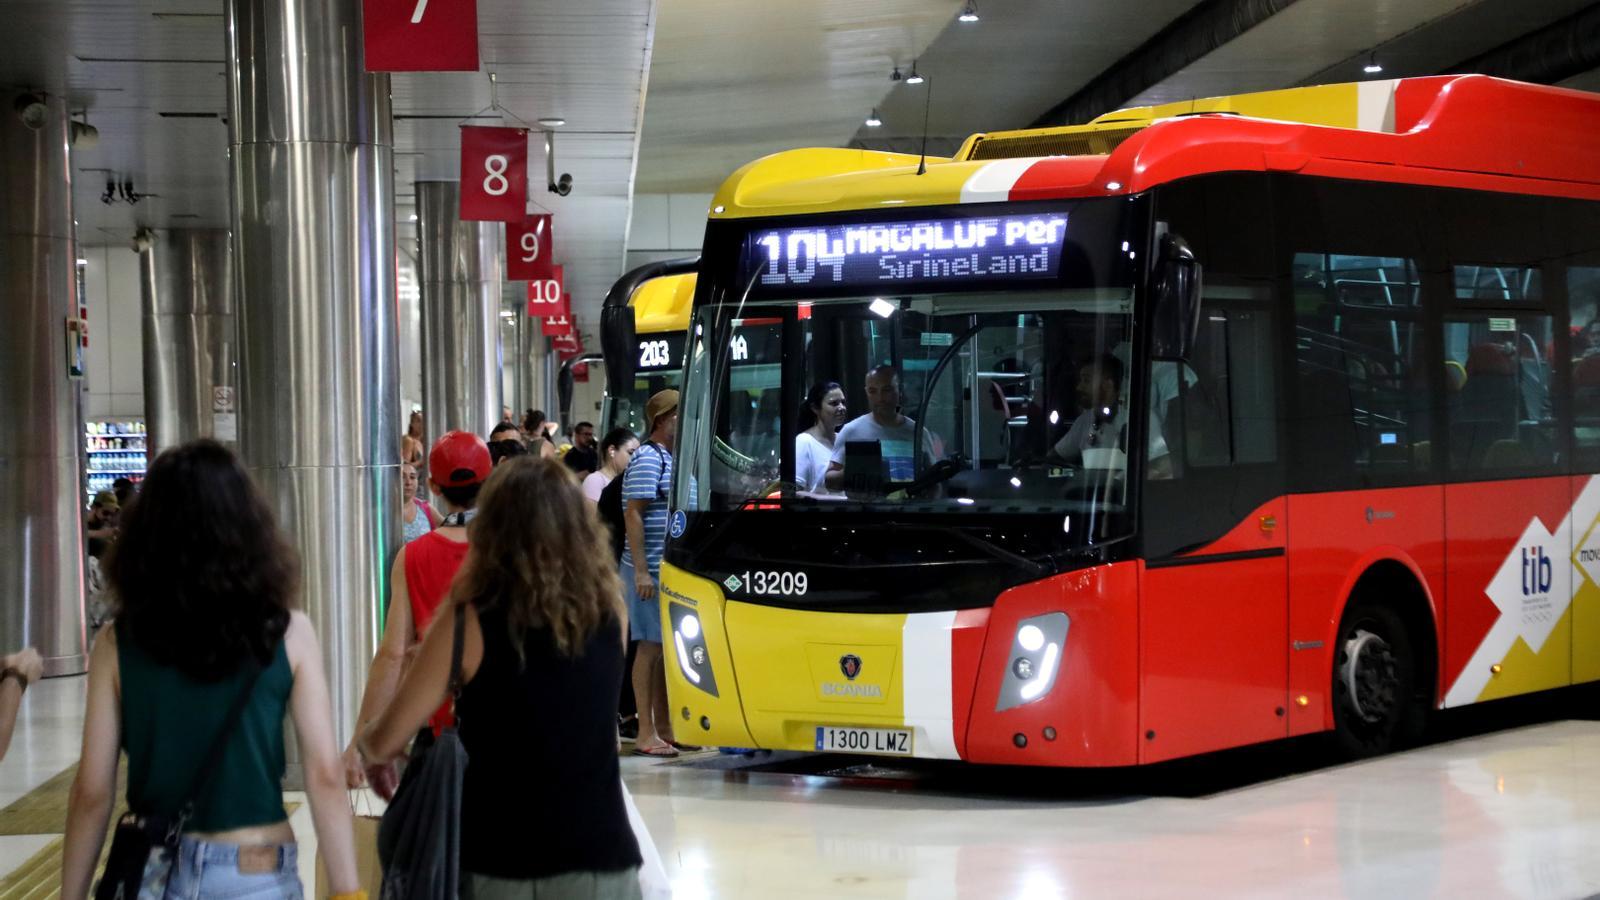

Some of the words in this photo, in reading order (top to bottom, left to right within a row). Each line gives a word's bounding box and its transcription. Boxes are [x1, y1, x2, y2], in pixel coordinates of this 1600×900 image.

[483, 154, 509, 196] 8
[520, 232, 539, 263] 9
[761, 228, 845, 285] 104
[845, 218, 1000, 255] MAGALUF
[1004, 217, 1067, 247] per
[532, 280, 560, 303] 10
[639, 340, 670, 367] 203
[742, 570, 808, 595] 13209
[1522, 545, 1552, 596] tib
[821, 681, 882, 698] SCANIA
[829, 728, 870, 750] 1300
[875, 730, 908, 752] LMZ
